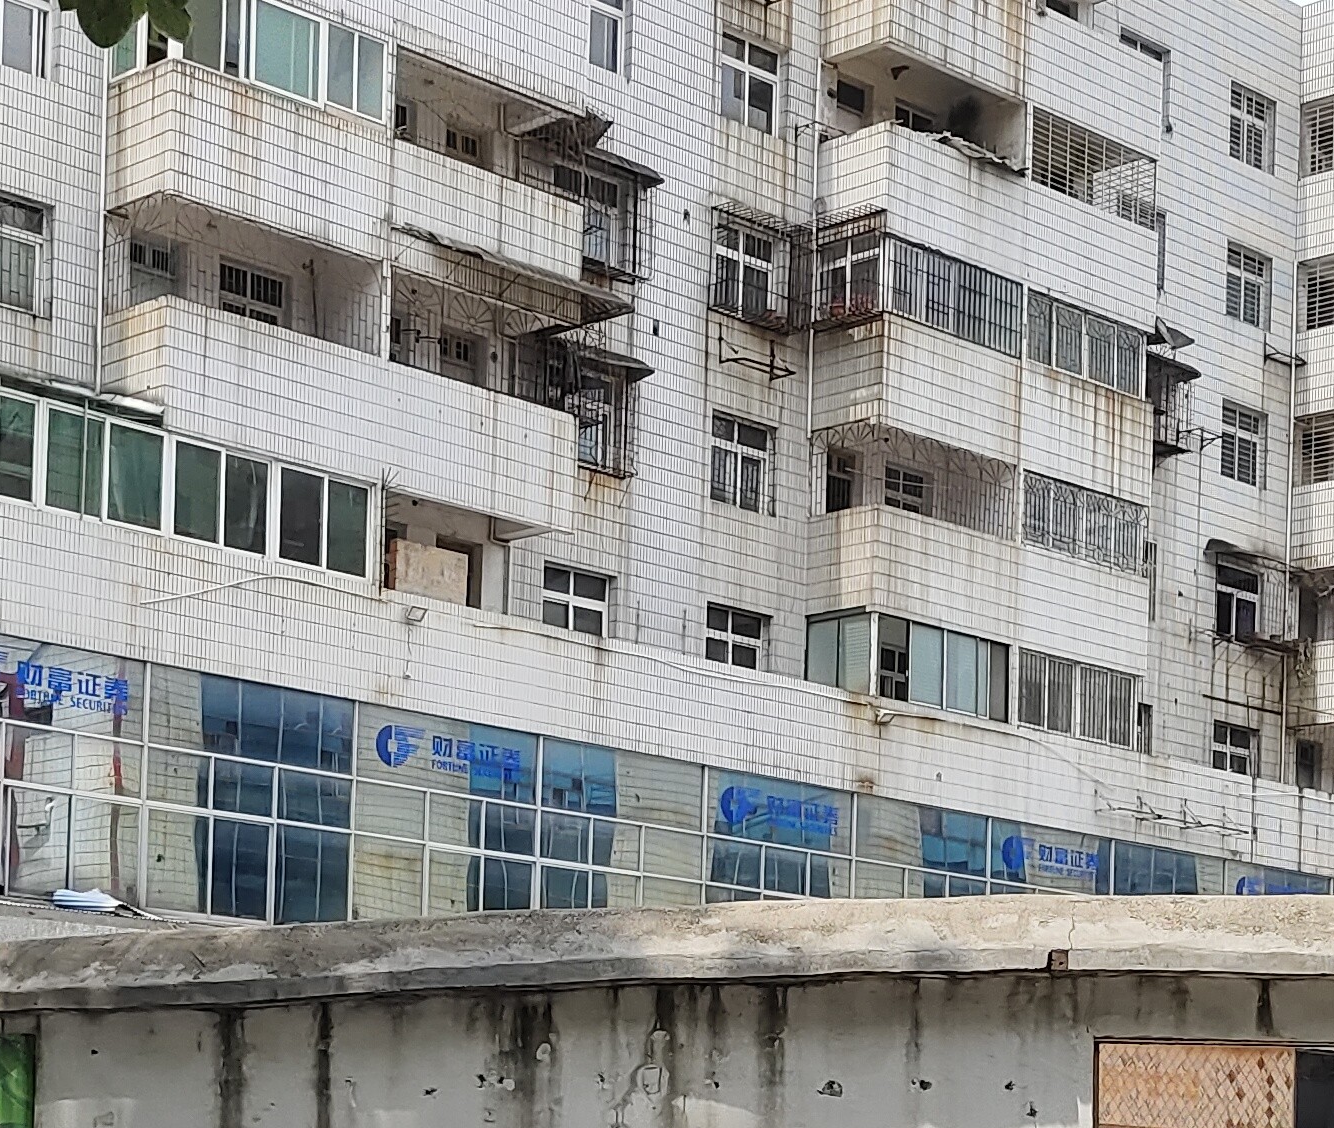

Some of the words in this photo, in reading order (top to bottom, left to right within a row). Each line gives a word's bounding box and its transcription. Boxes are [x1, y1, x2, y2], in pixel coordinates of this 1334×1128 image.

[17, 660, 129, 704] 财富证券
[431, 735, 520, 771] 财富证券
